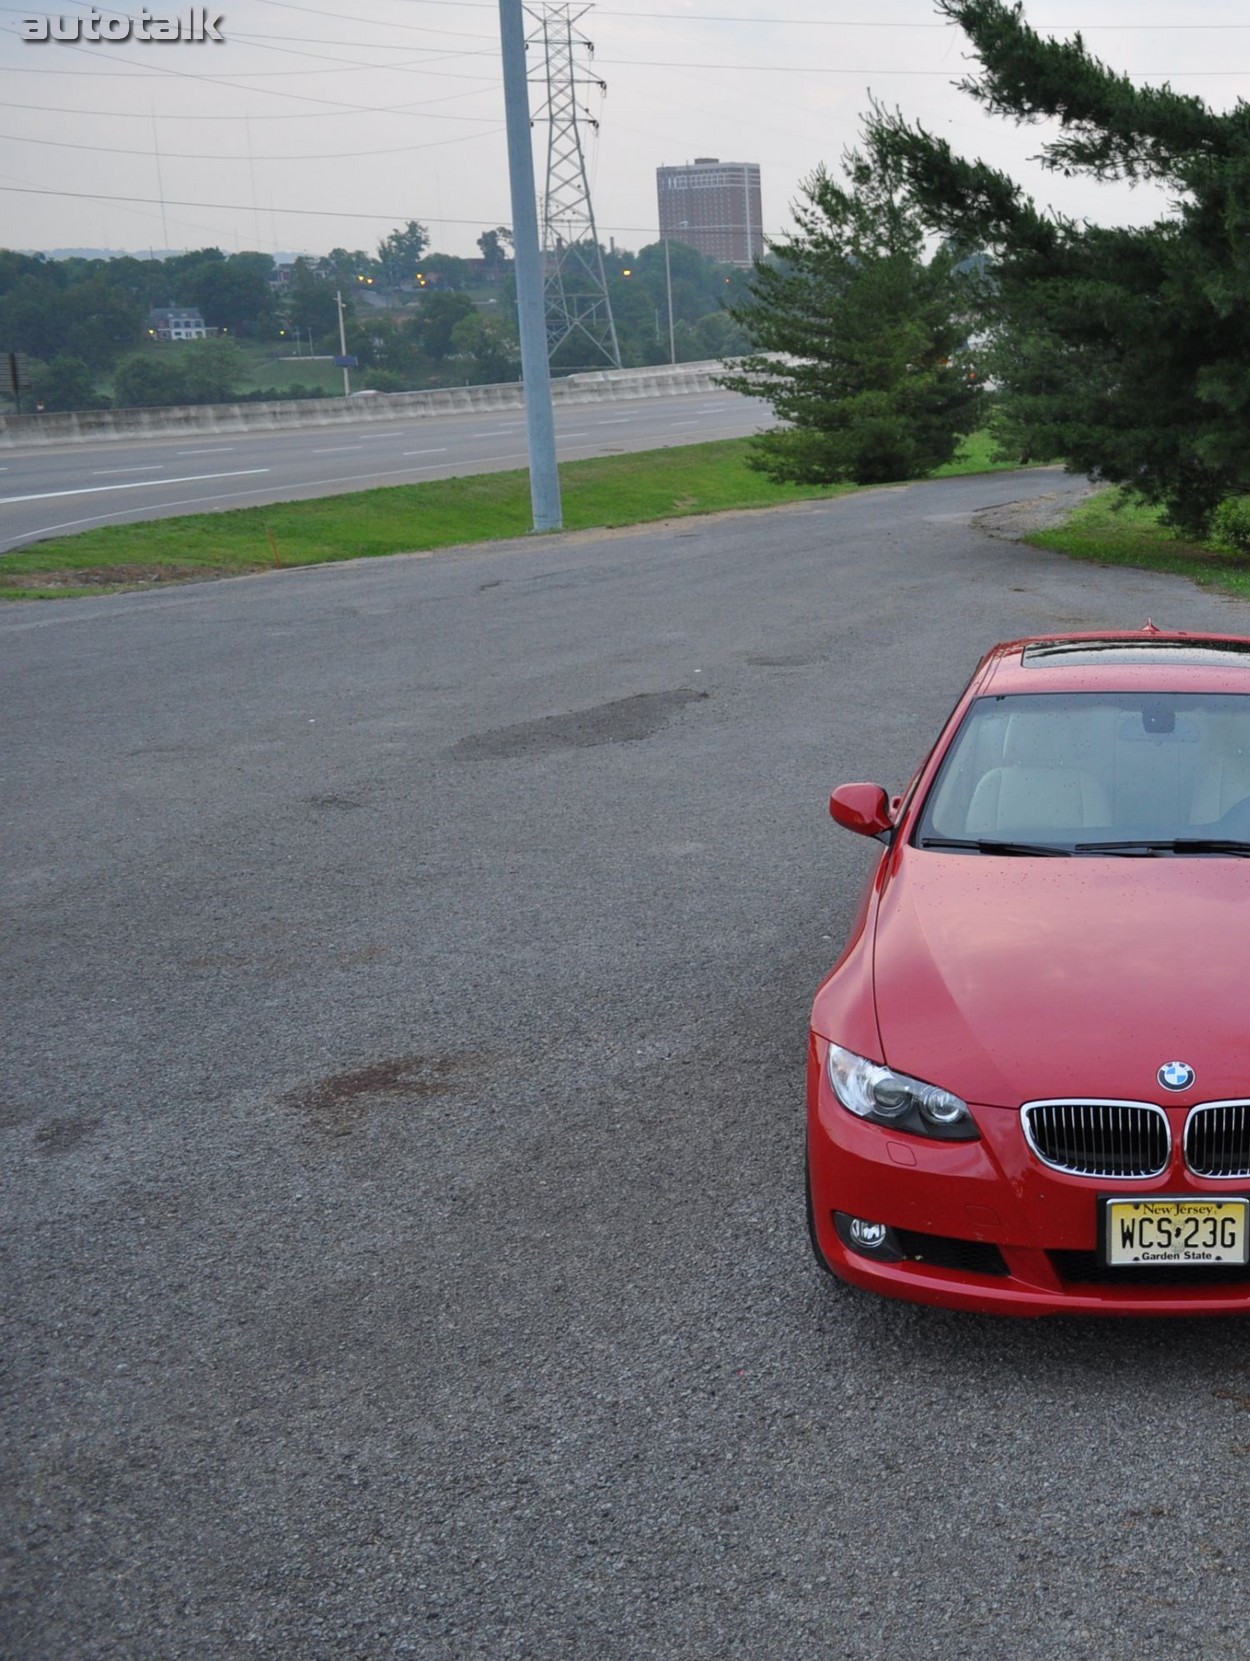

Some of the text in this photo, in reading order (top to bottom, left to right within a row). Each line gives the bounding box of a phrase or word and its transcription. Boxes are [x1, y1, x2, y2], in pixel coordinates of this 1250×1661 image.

[1143, 1204, 1214, 1216] New Jersey
[1142, 1251, 1212, 1261] Garden State
